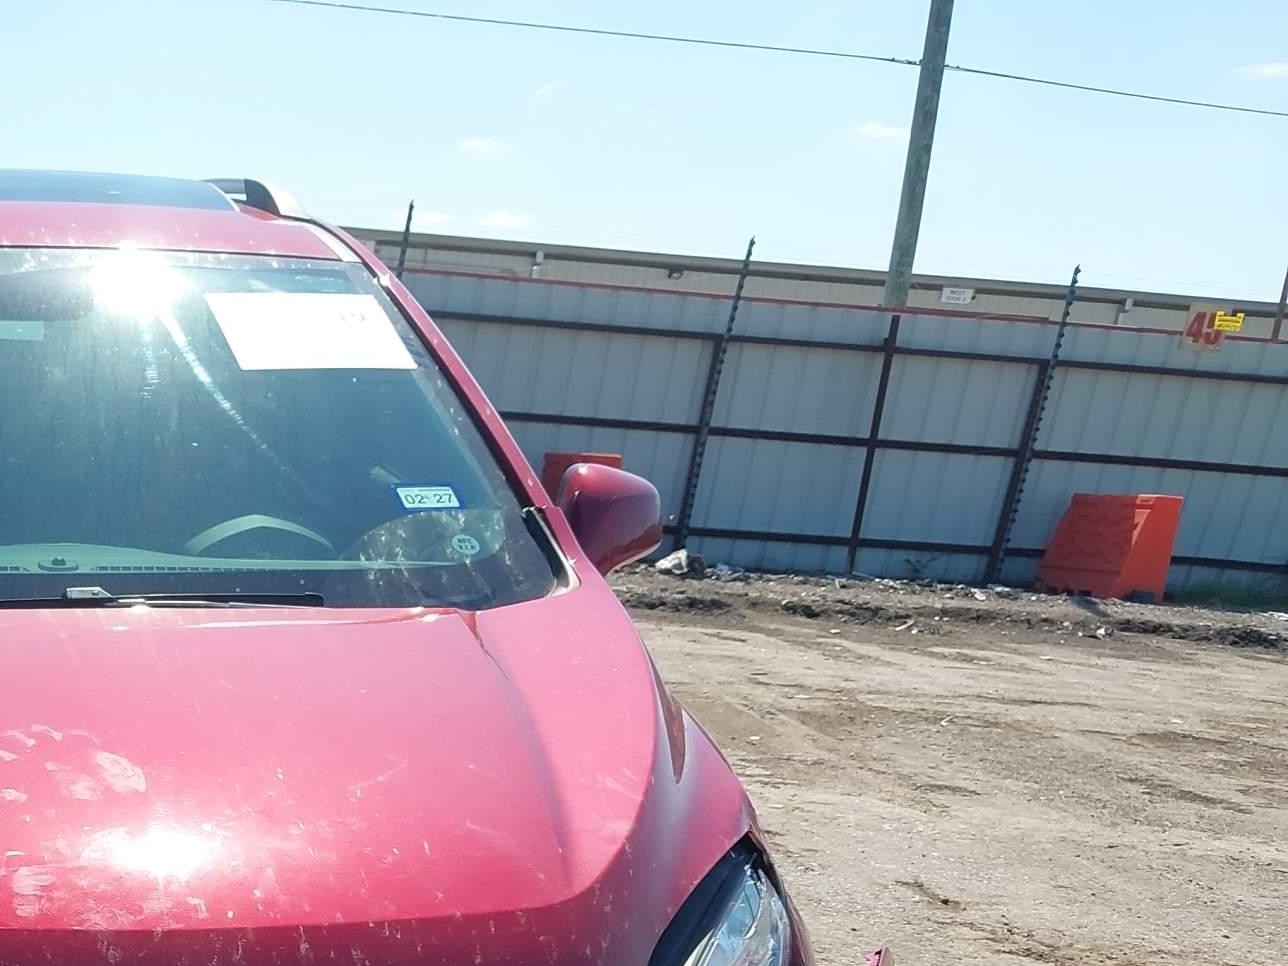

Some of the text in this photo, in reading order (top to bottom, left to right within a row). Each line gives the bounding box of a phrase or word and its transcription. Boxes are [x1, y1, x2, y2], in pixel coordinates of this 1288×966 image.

[1186, 311, 1221, 344] 45
[404, 493, 453, 505] 02 27
